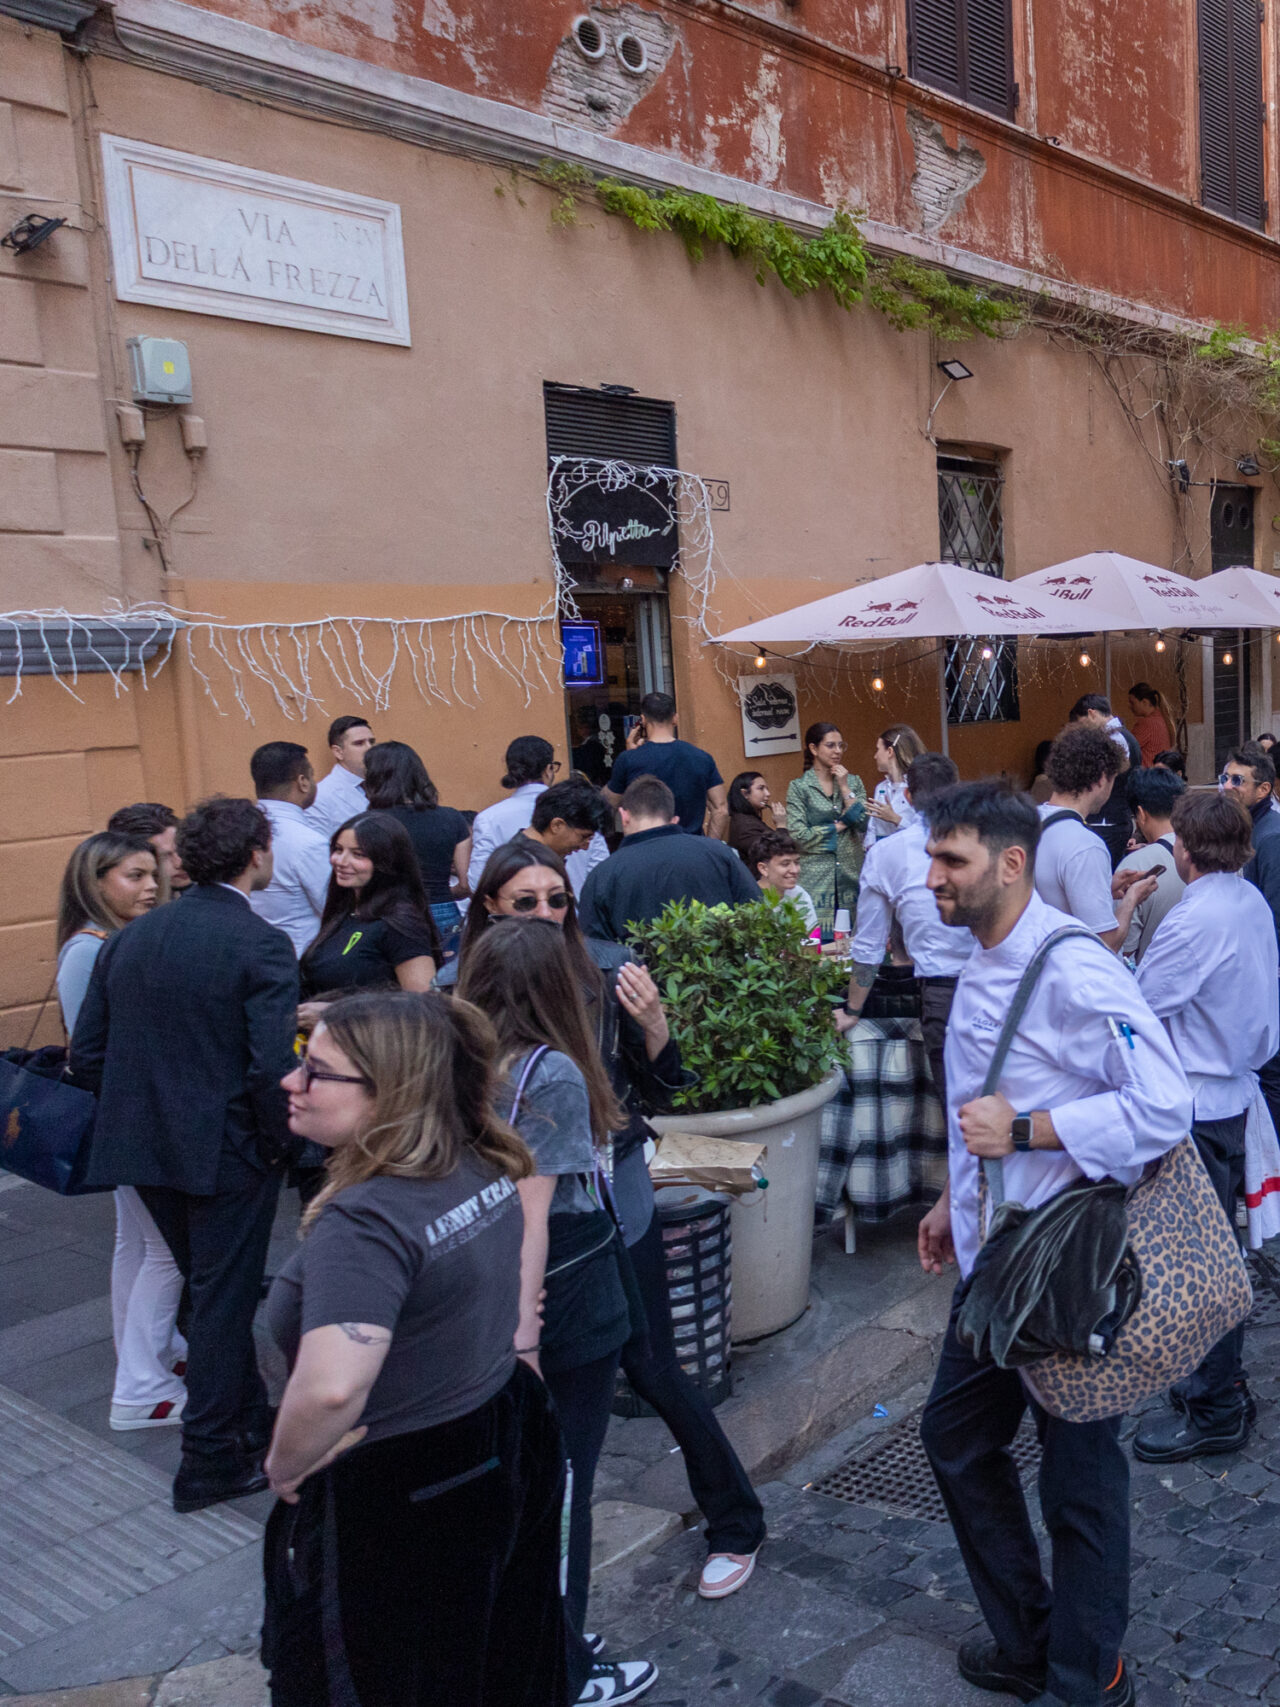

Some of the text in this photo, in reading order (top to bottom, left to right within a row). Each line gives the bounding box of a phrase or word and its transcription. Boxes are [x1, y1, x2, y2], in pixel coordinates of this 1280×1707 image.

[238, 208, 296, 246] VIA
[145, 236, 384, 307] DELLA FREZZA
[1059, 588, 1093, 600] Bull
[838, 612, 919, 628] Red Bull
